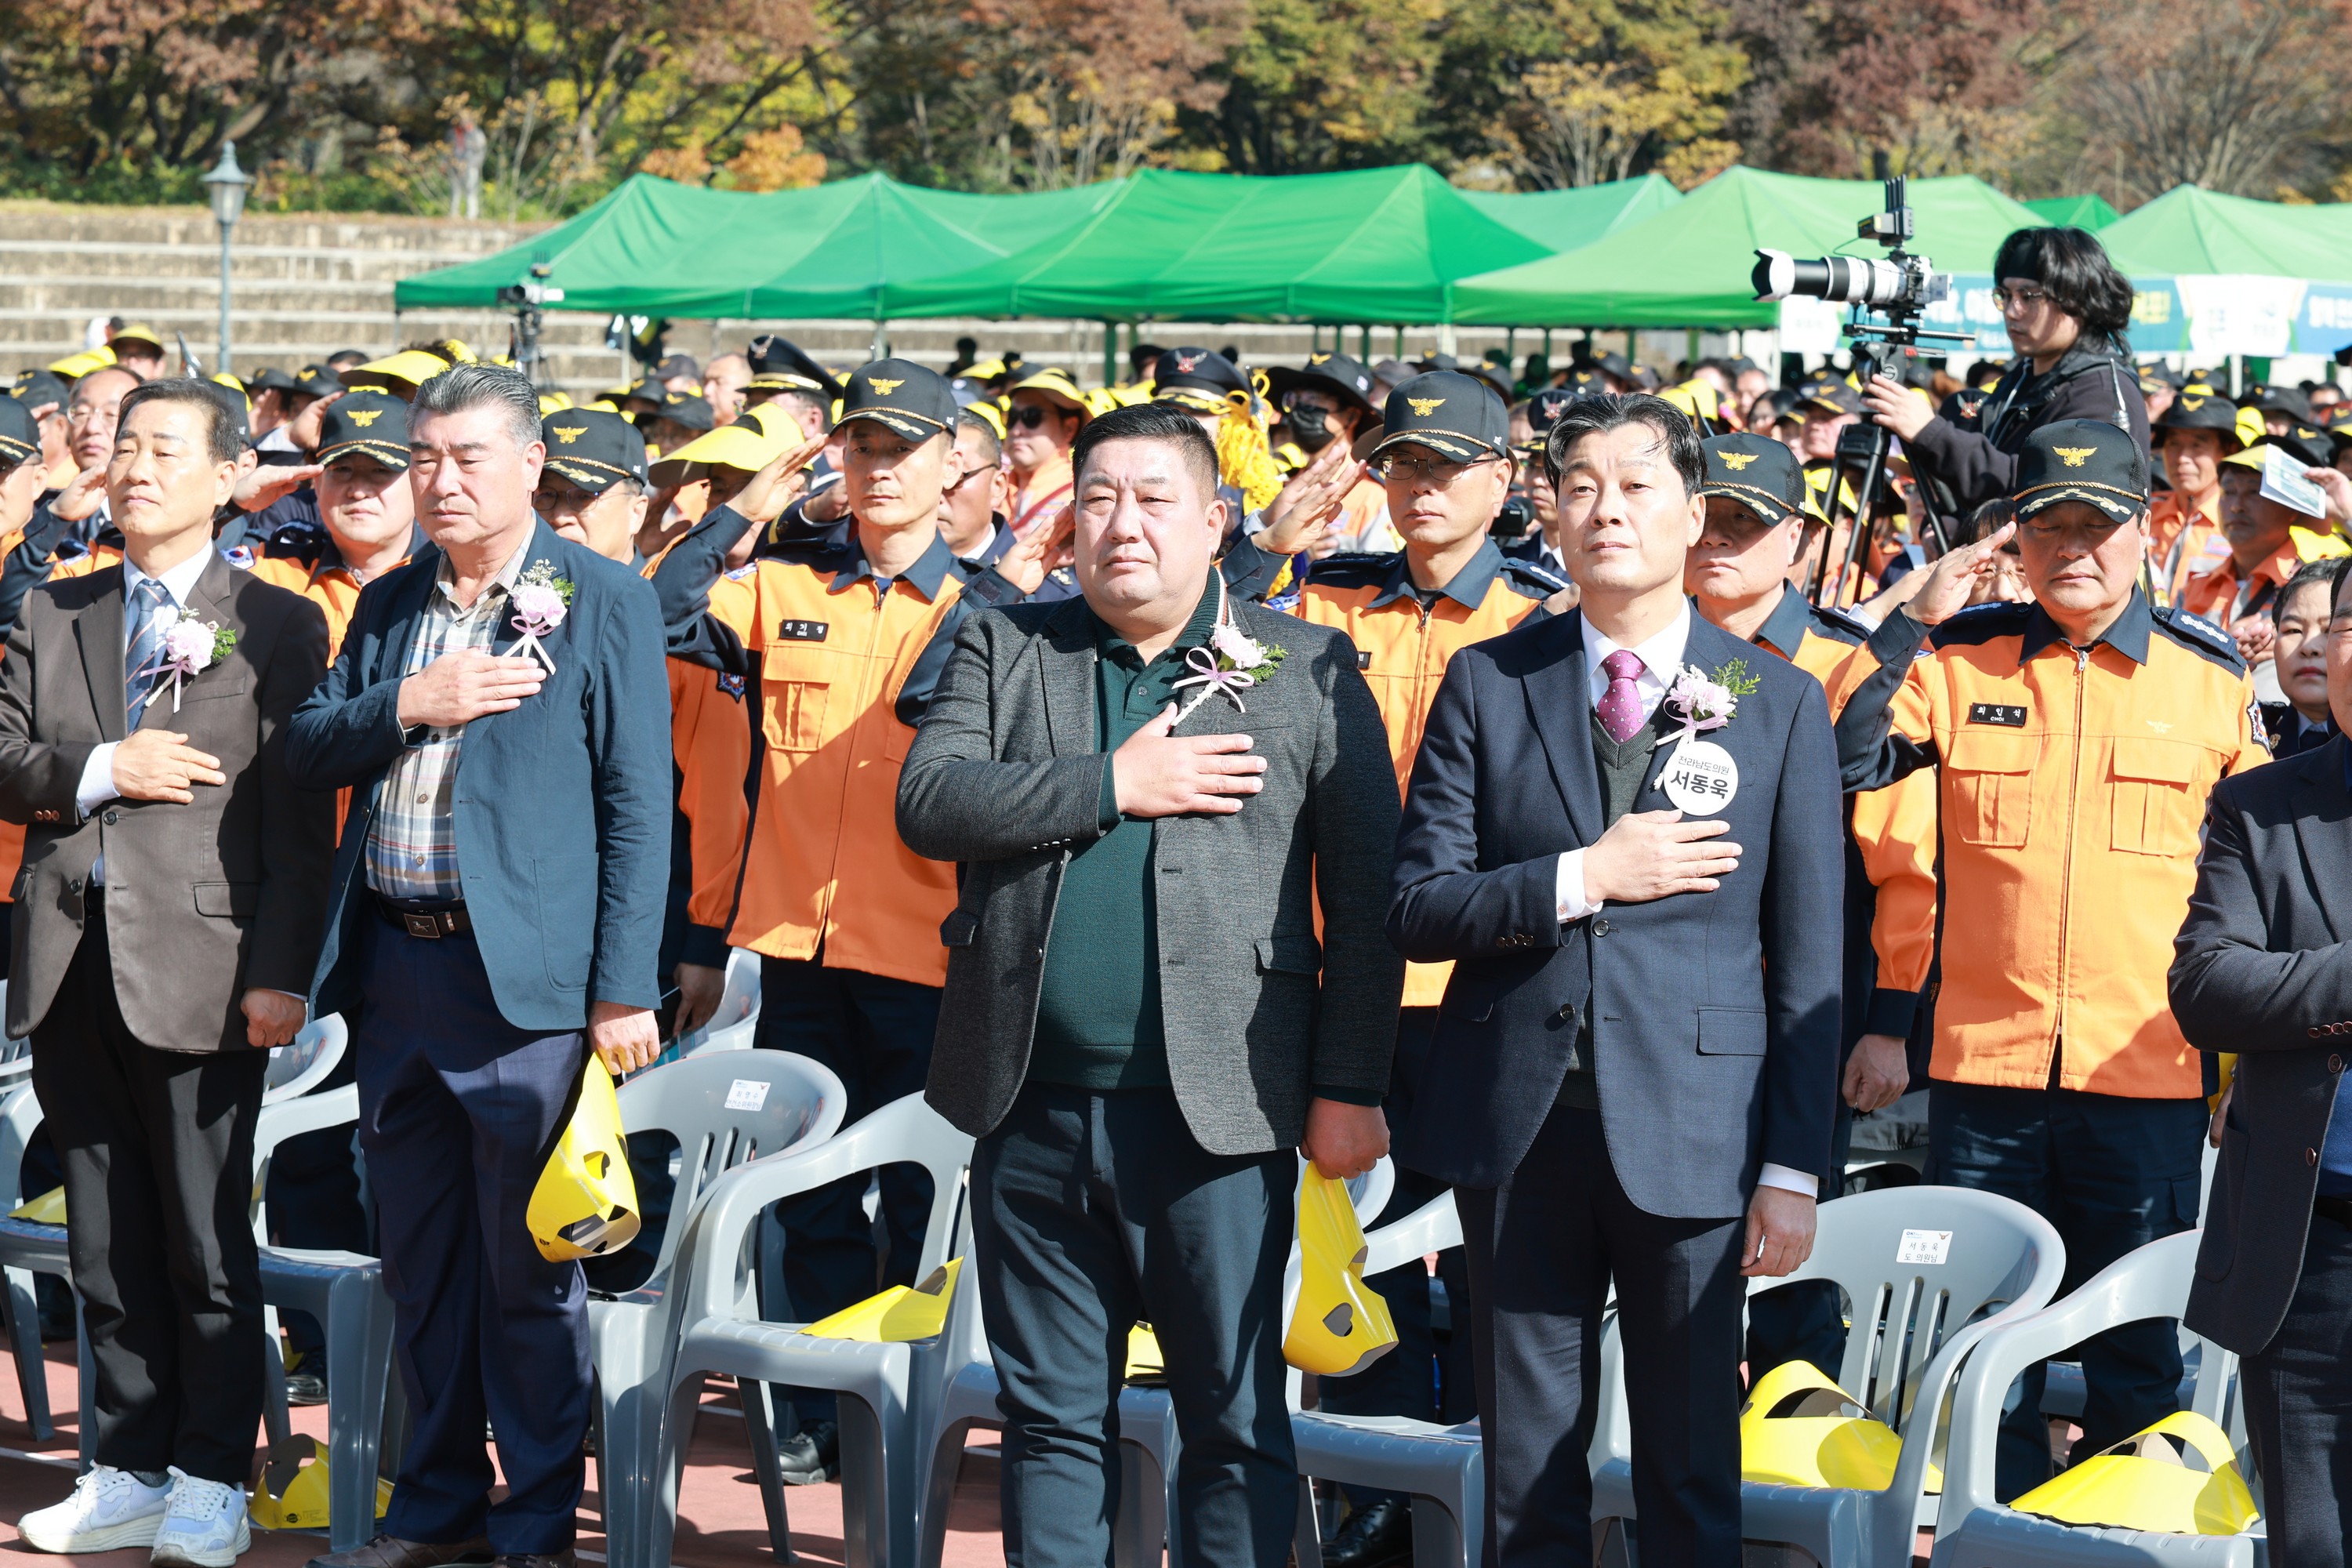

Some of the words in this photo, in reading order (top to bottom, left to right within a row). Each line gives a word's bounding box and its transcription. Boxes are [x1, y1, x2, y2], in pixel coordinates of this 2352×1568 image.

[1679, 756, 1730, 775] 전라남도의원
[1670, 770, 1729, 800] 서동욱
[1915, 1253, 1938, 1263] 의원님
